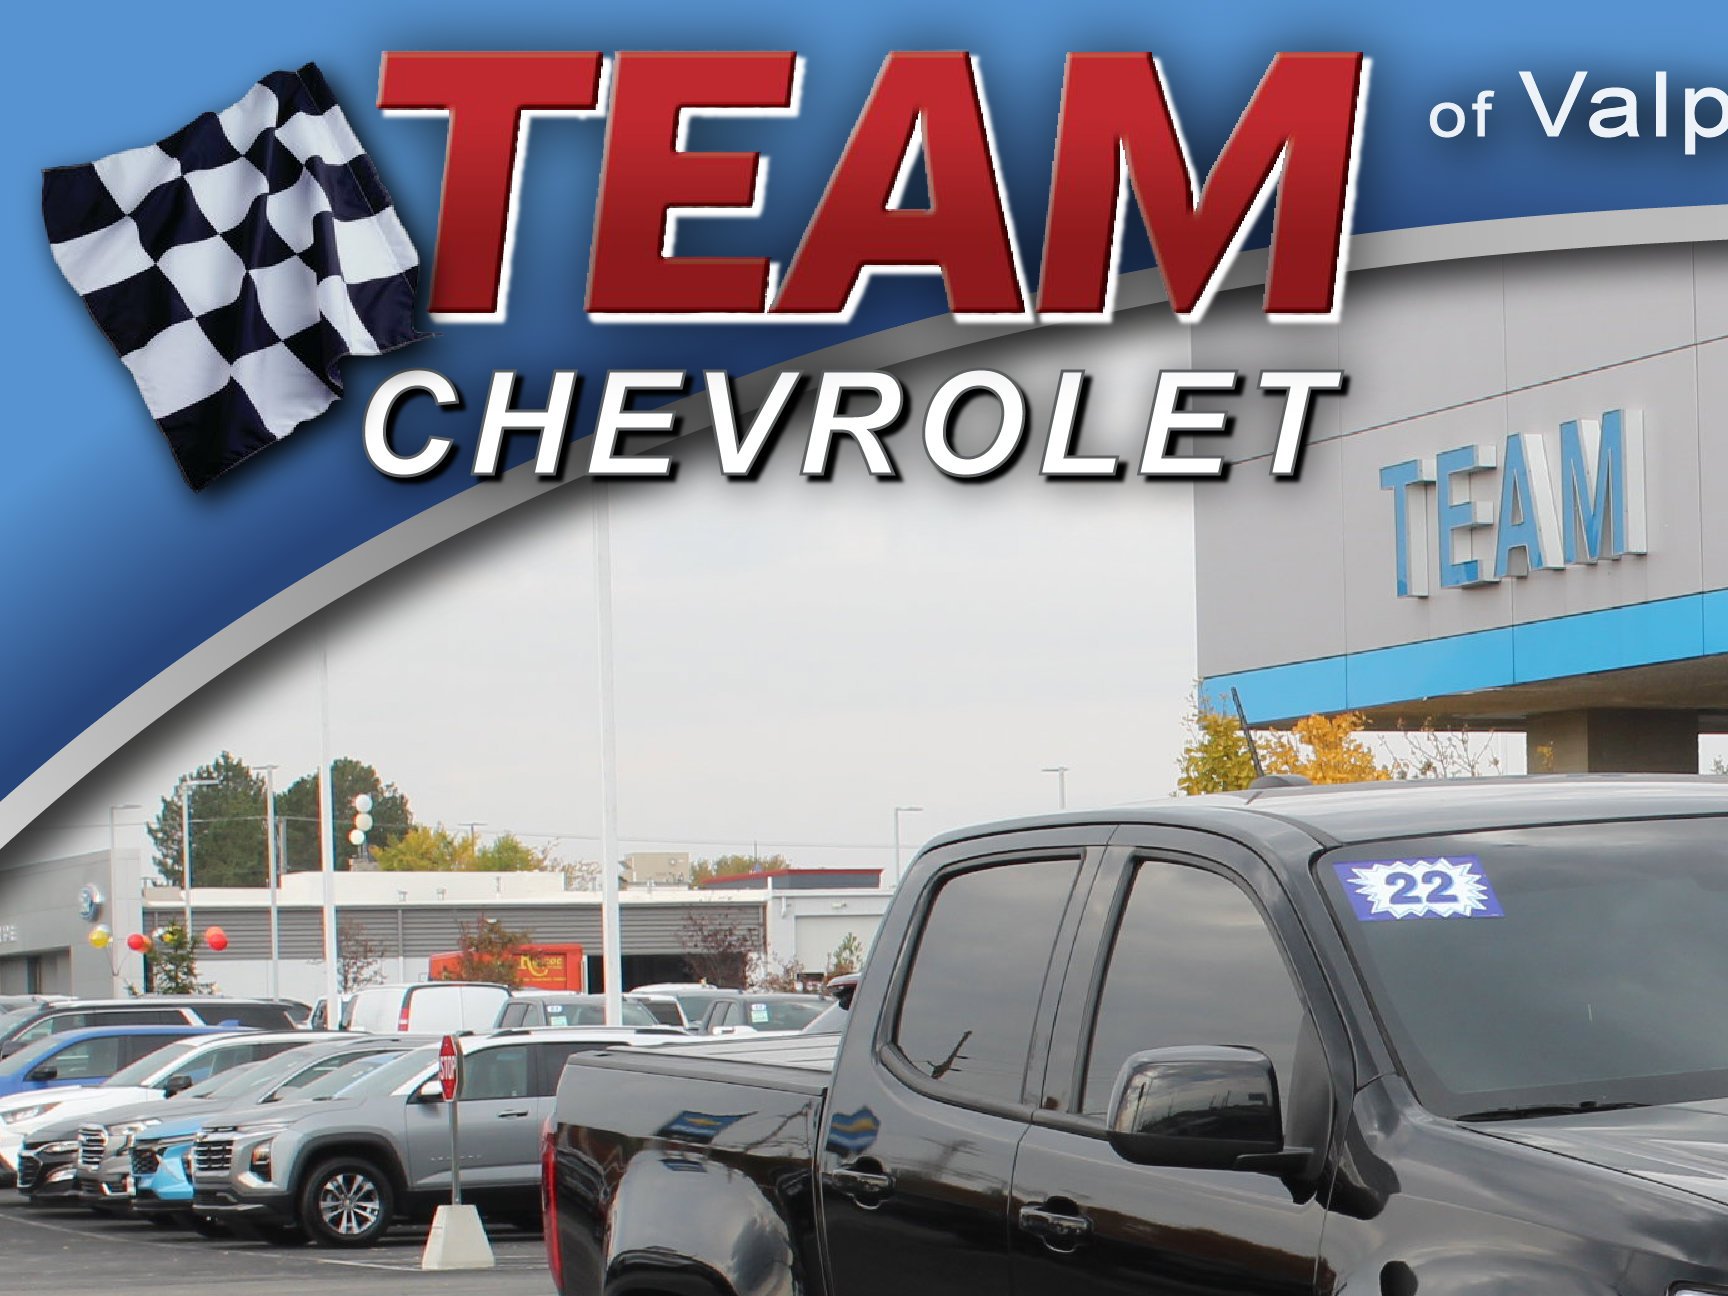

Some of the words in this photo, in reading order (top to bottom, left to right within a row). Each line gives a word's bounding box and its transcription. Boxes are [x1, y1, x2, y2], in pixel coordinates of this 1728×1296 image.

[1379, 409, 1648, 598] TEAM
[1385, 869, 1459, 905] 22
[439, 1055, 456, 1080] STOP
